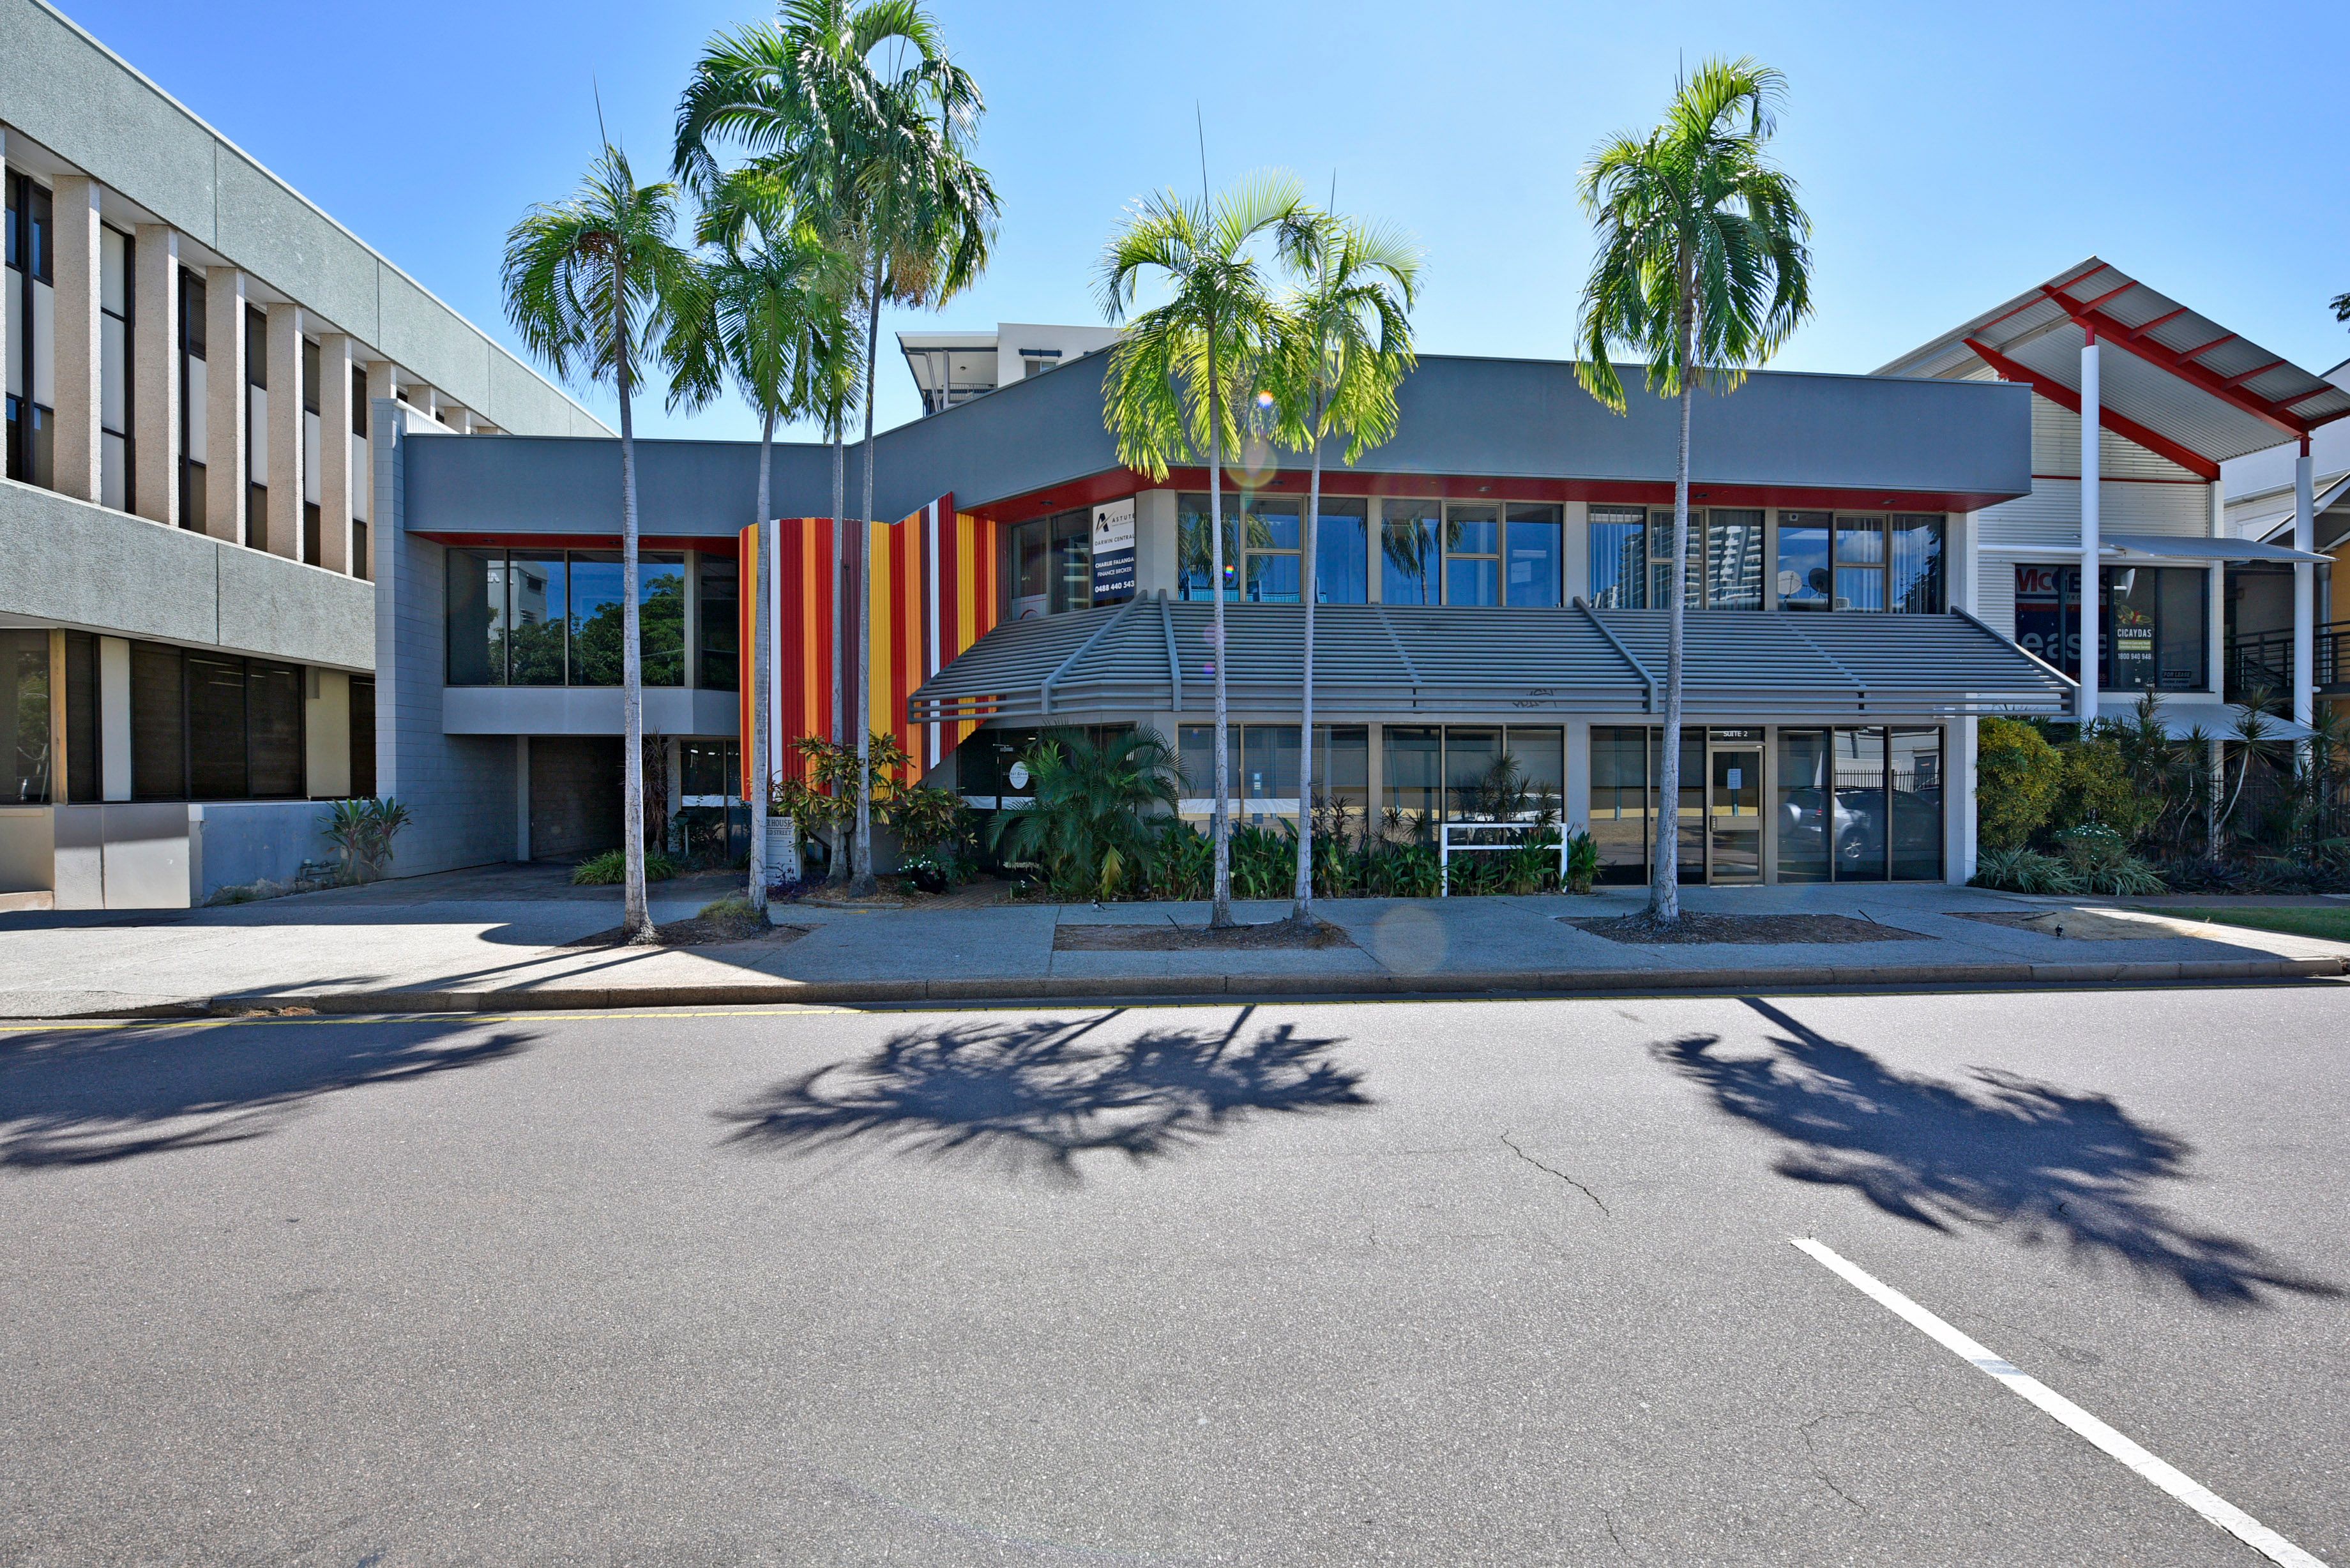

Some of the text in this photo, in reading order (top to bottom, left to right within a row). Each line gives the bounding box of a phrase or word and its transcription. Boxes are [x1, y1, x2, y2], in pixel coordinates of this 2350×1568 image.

[1112, 513, 1135, 523] ASTUTE
[1114, 534, 1135, 542] CENTRAL
[1113, 557, 1134, 565] FALANGA
[1095, 584, 1109, 593] 0488
[1123, 580, 1135, 589] 543
[2117, 628, 2152, 637] CICAYDAS
